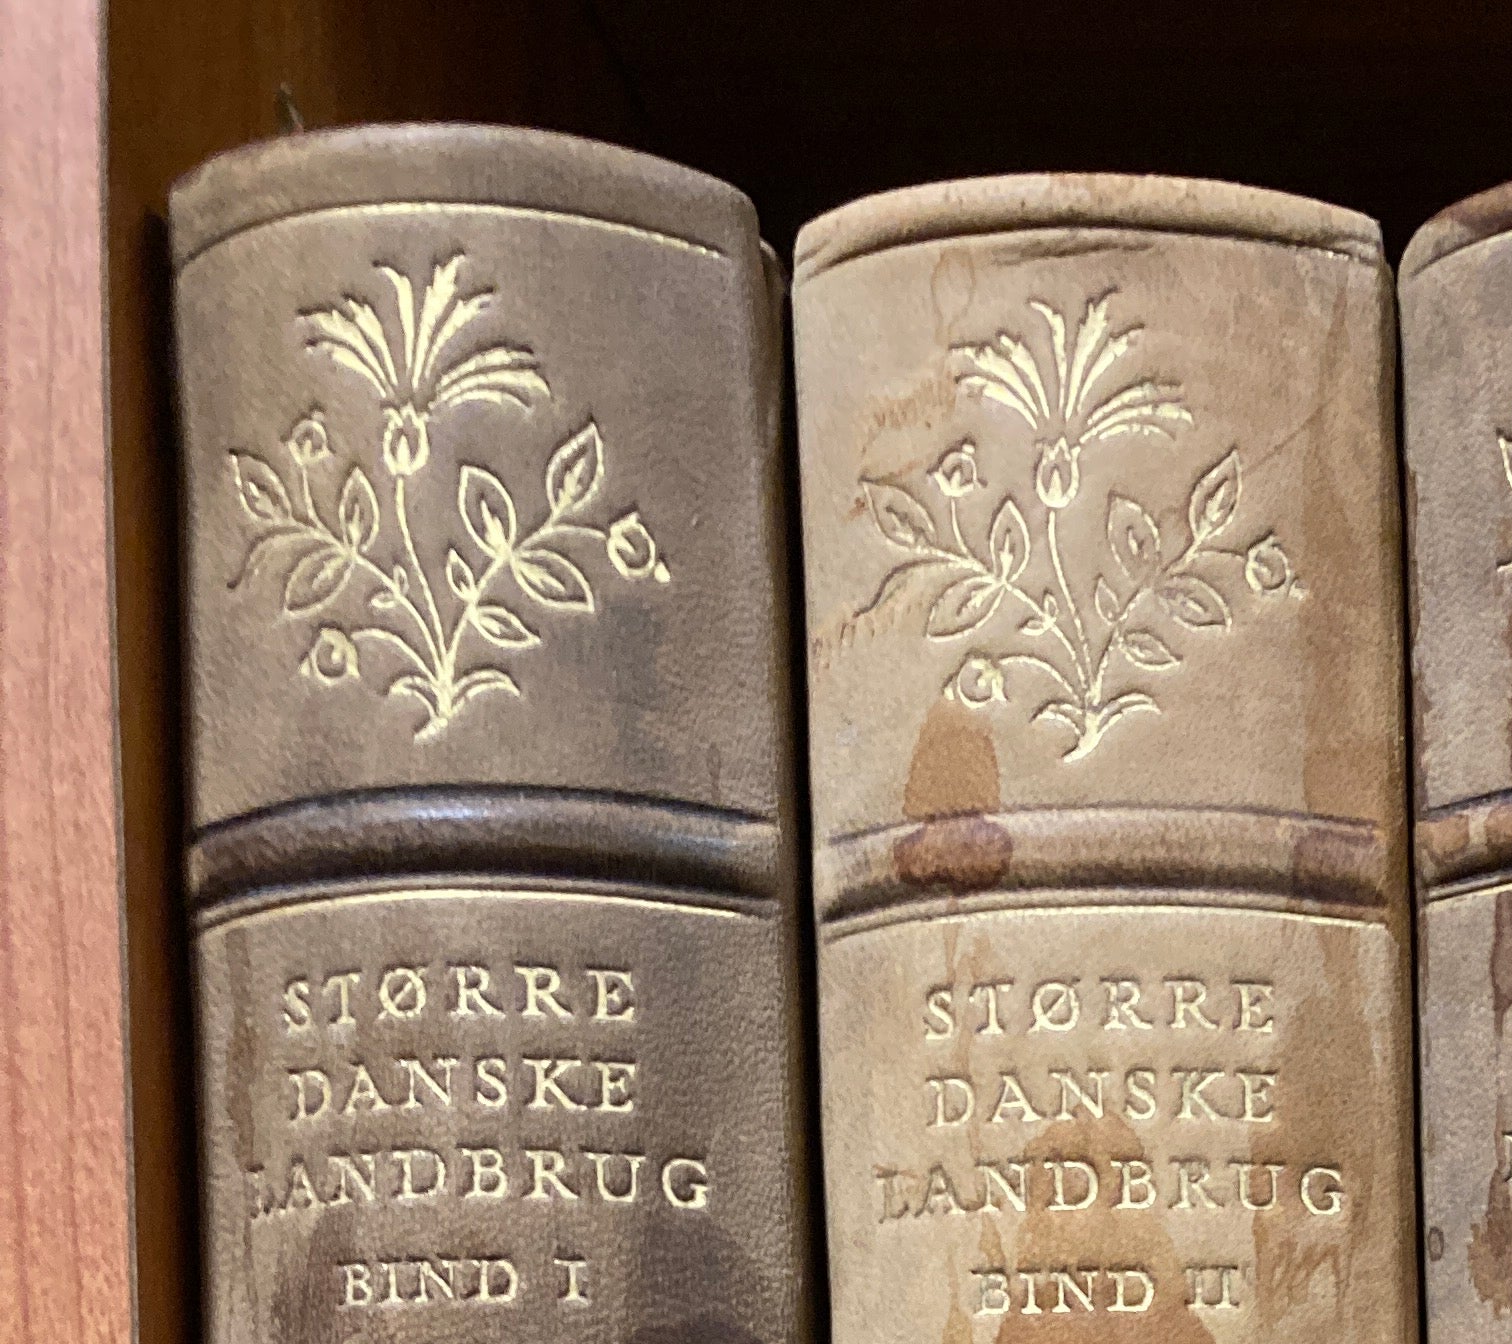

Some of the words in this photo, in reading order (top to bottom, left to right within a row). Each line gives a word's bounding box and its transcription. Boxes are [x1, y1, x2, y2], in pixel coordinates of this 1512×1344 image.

[283, 965, 636, 1032] STØRRE
[924, 979, 1275, 1040] STØRRE
[289, 1057, 637, 1121] DANSKE
[926, 1069, 1279, 1127] DANSKE
[247, 1148, 710, 1219] LANDBRUG
[875, 1159, 1344, 1223] LANDBRUG
[340, 1257, 517, 1306] BIND
[554, 1258, 591, 1303] I
[971, 1266, 1155, 1315] BIND
[1185, 1265, 1241, 1310] II
